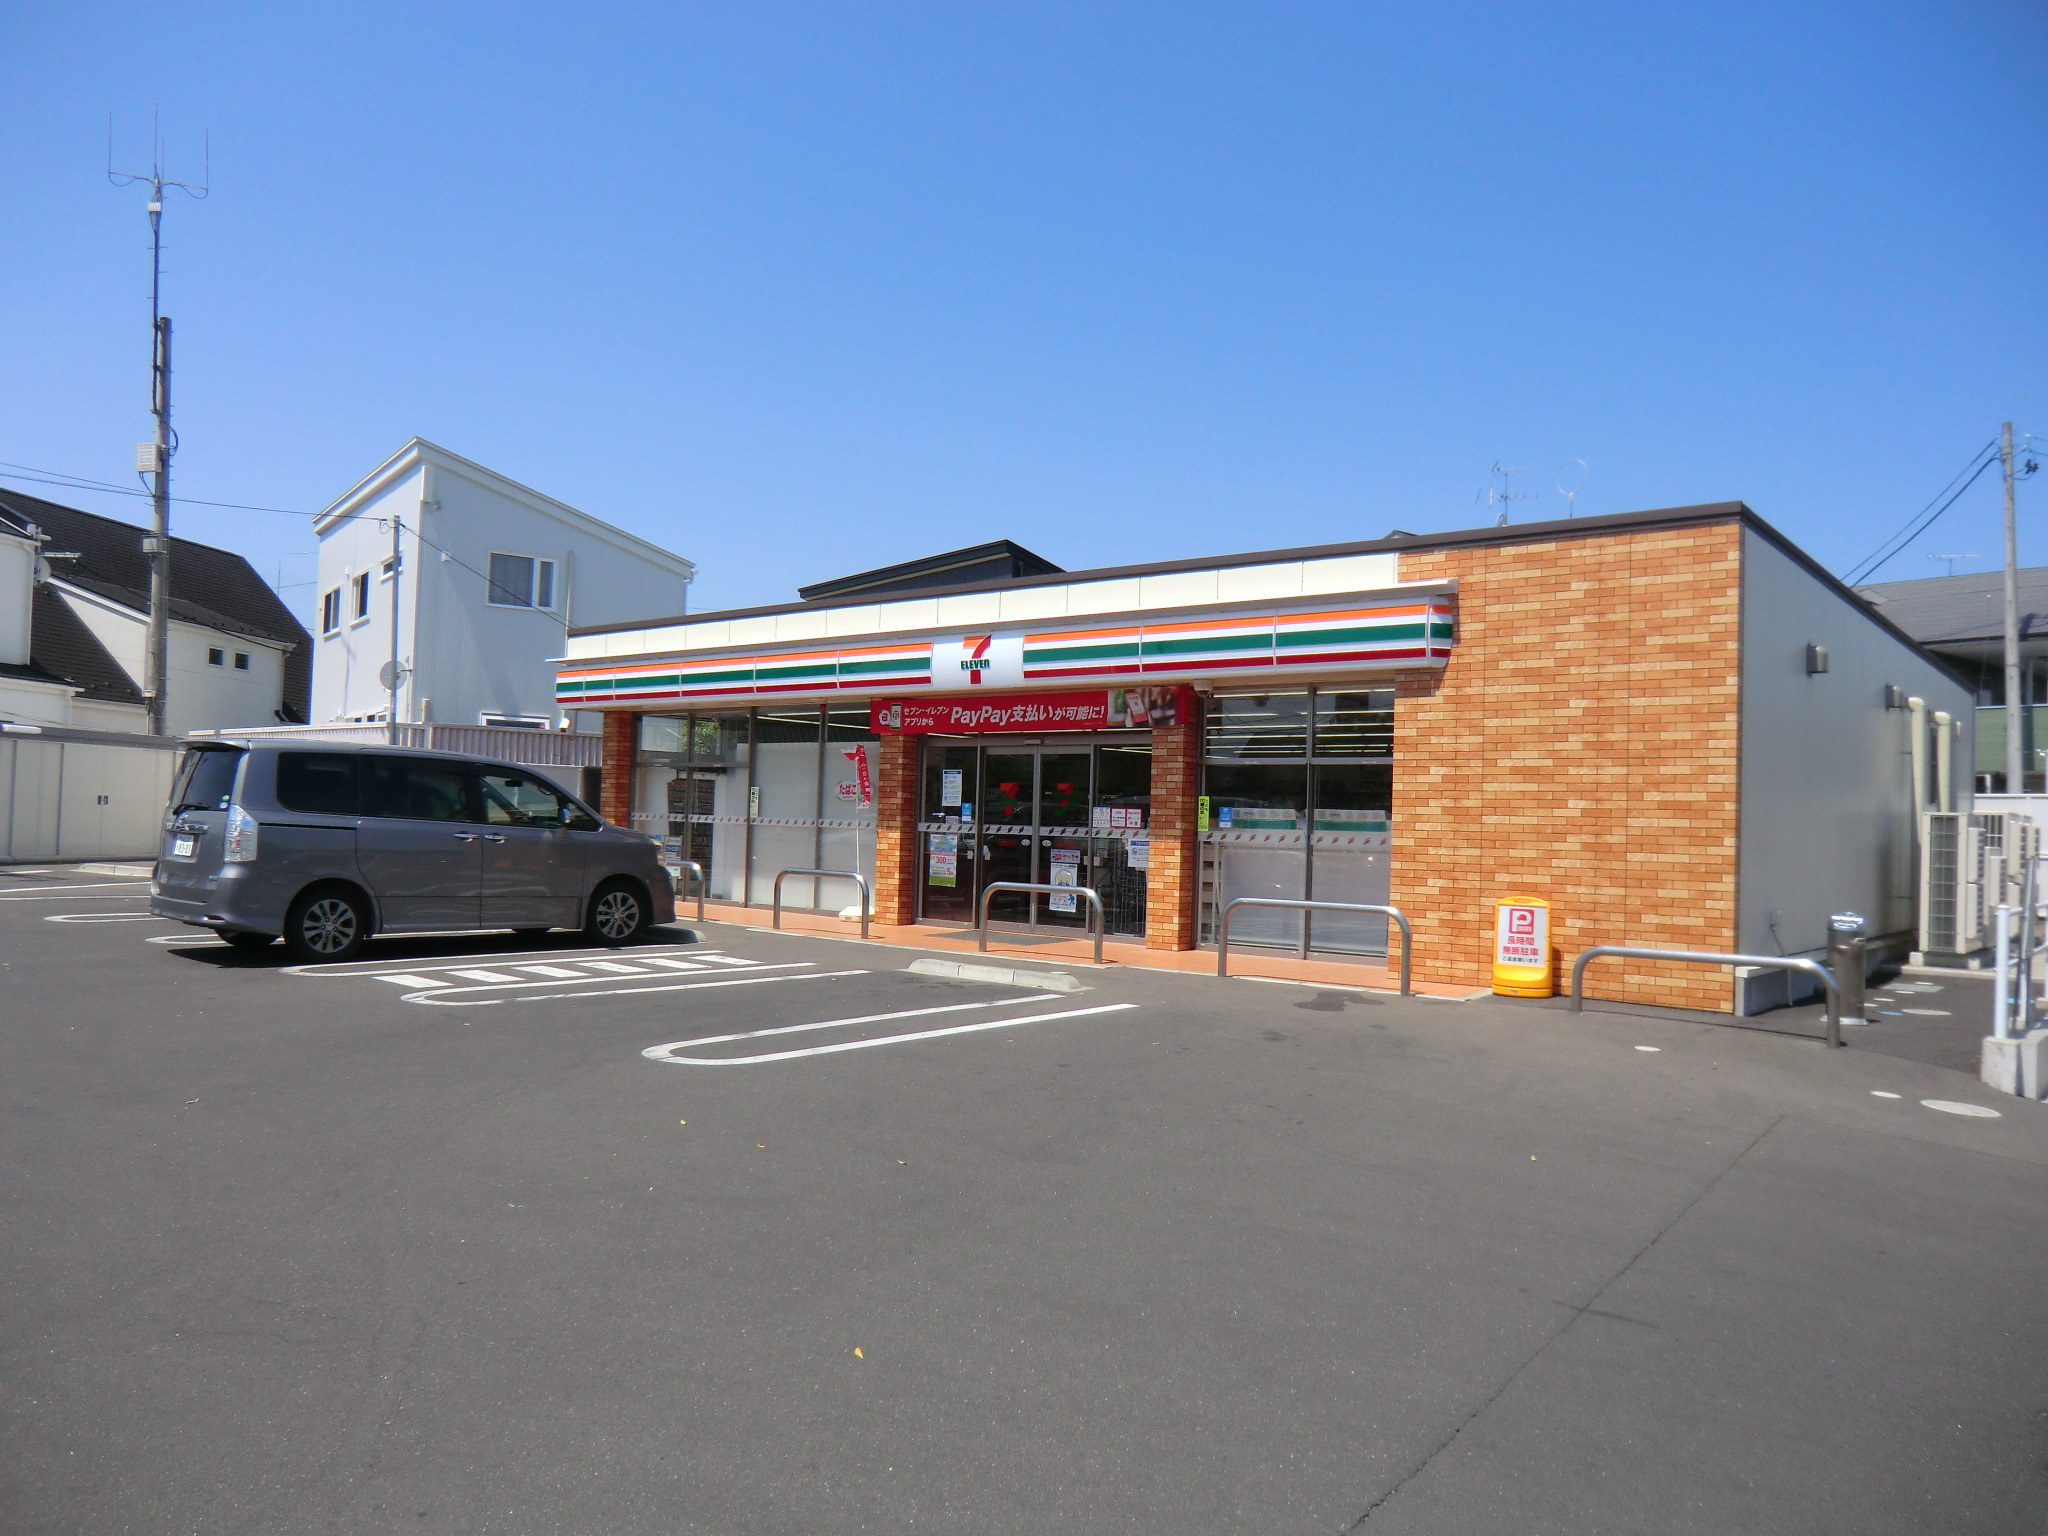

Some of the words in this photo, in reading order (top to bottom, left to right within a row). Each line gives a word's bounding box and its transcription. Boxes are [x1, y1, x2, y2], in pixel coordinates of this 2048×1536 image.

[903, 717, 934, 727] アプリから
[839, 784, 857, 795] たばこ
[1507, 935, 1535, 946] 長時間
[1502, 946, 1539, 957] 無断駐車
